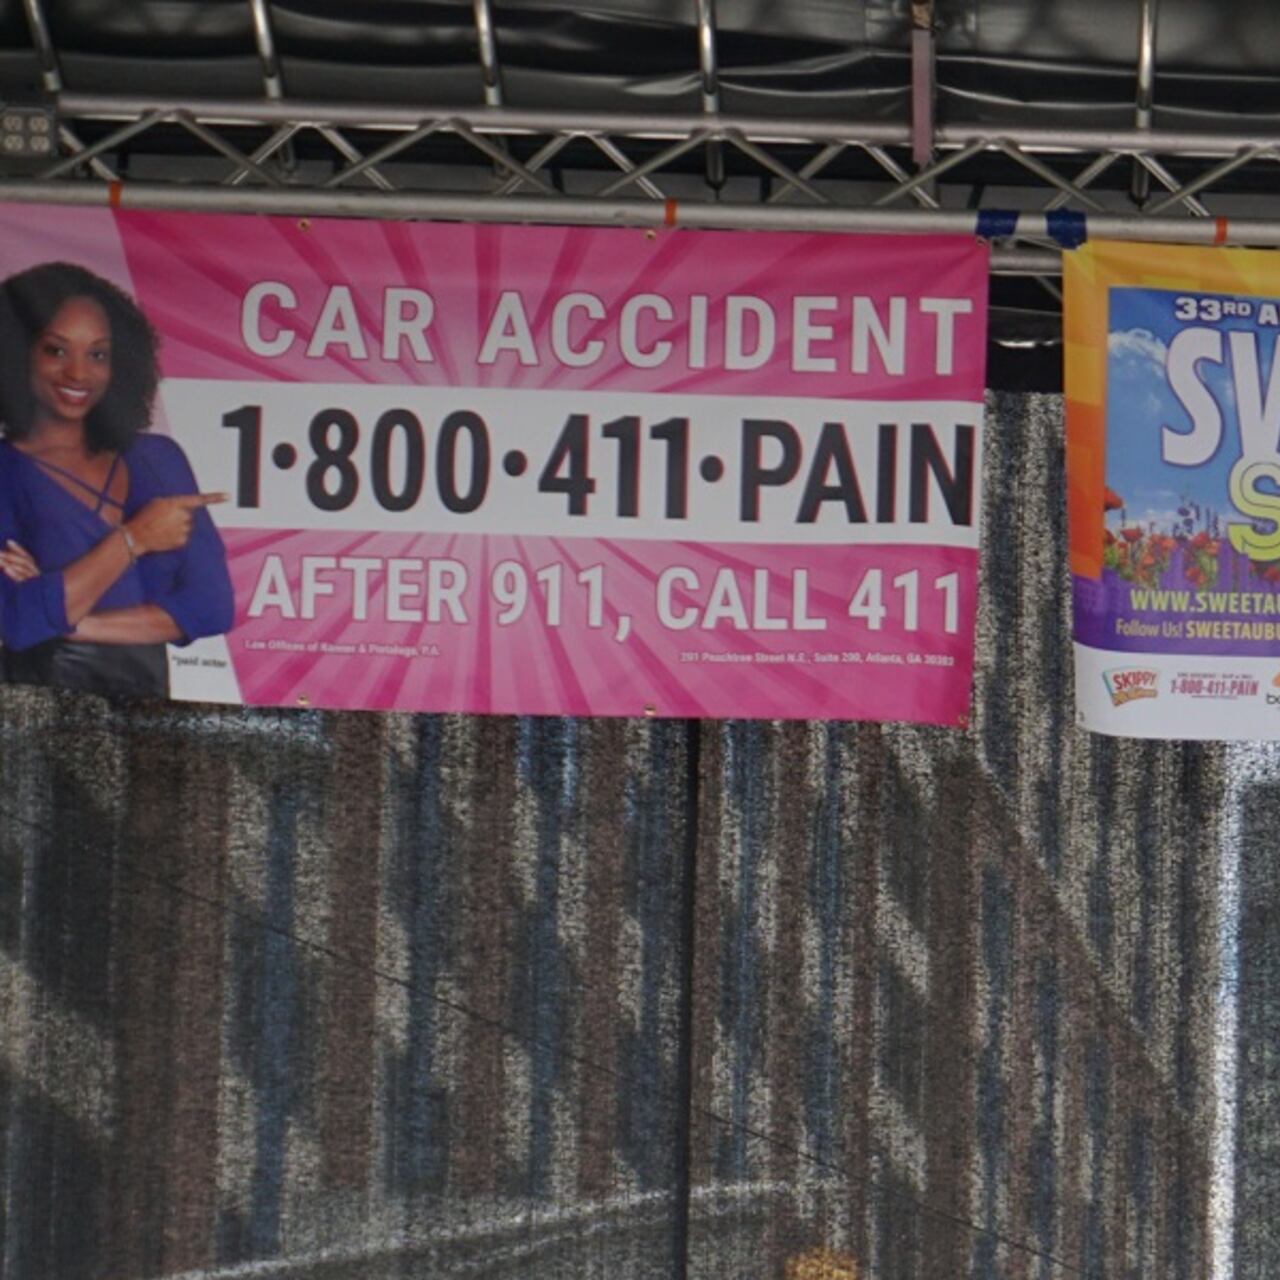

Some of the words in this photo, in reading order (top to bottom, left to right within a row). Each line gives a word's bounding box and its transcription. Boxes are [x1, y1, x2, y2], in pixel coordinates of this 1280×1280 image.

[1175, 296, 1251, 321] 33RD
[240, 281, 437, 365] CAR
[476, 290, 974, 376] ACCIDENT
[248, 556, 469, 625] AFTER
[491, 560, 630, 643] 911,
[656, 565, 828, 633] CALL
[848, 570, 962, 637] 411
[1115, 618, 1157, 637] Follow
[1162, 620, 1182, 638] Us!
[1112, 670, 1157, 690] SKIPPY
